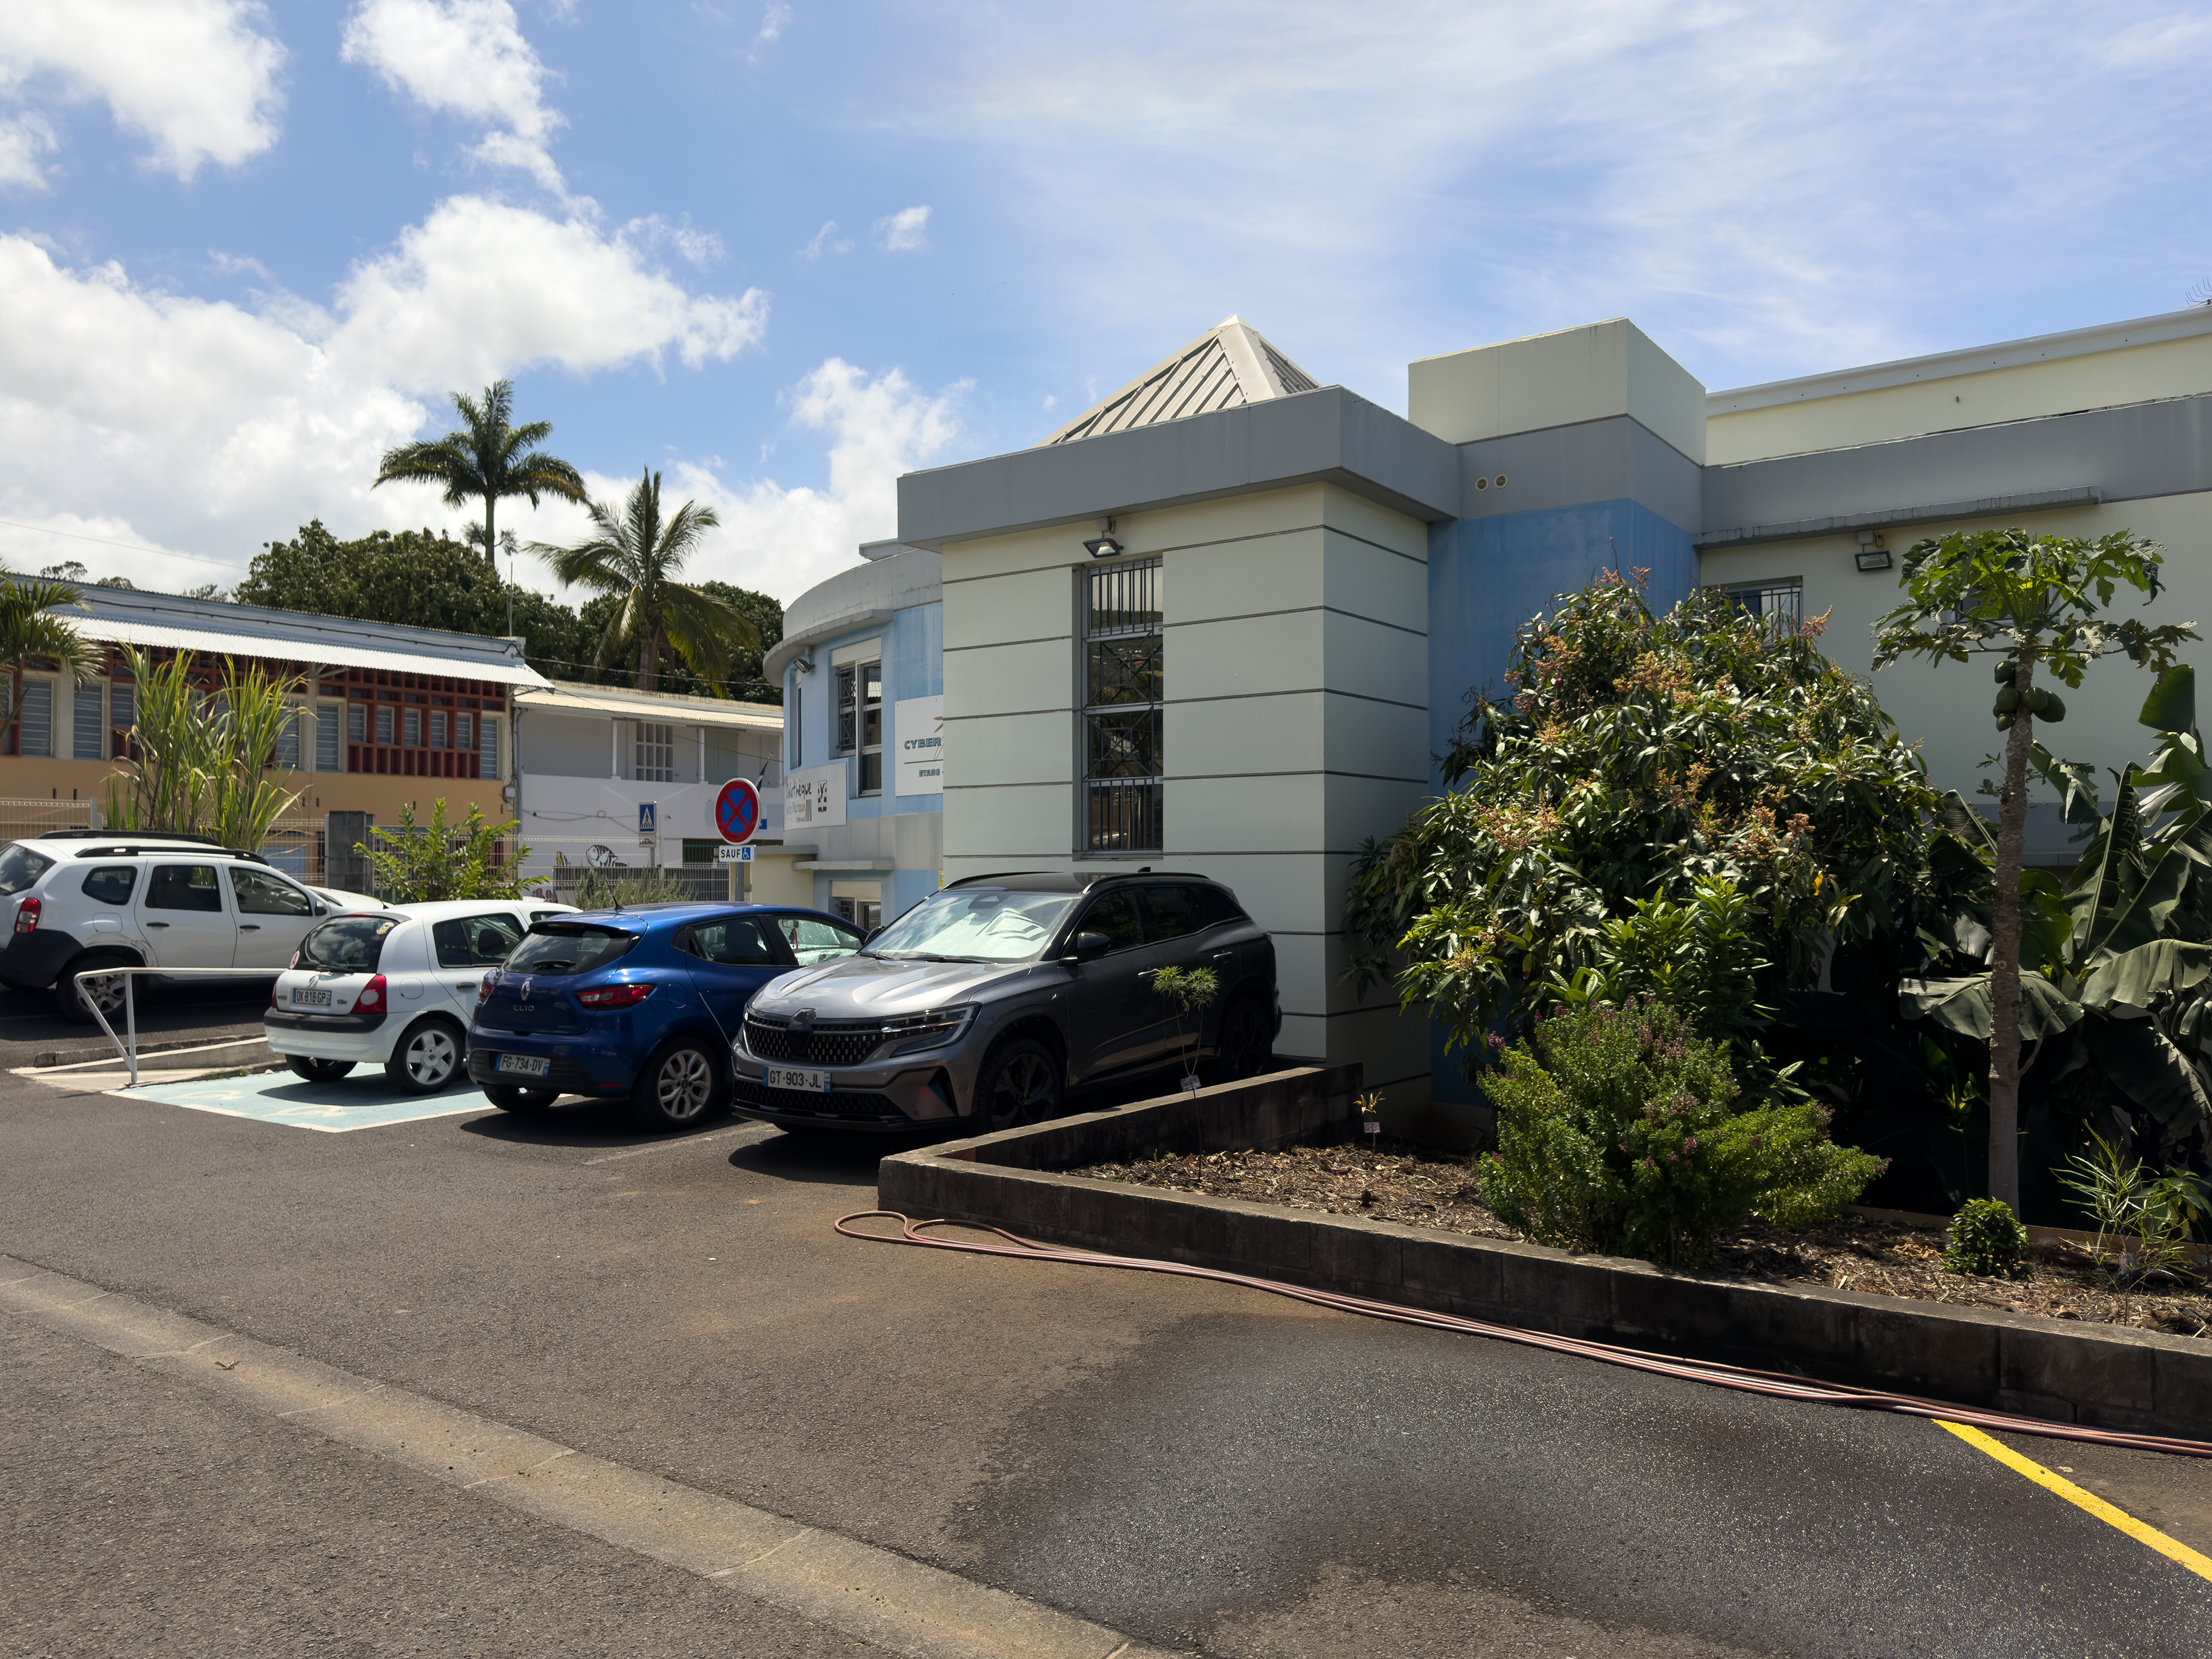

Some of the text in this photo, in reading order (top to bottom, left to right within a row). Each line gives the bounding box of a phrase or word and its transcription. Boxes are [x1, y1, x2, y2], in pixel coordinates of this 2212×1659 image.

[904, 737, 941, 749] CYBER
[919, 768, 940, 777] ETANG
[721, 849, 741, 858] SAUF
[297, 991, 326, 1003] DK-818-GP
[501, 1056, 543, 1071] FG-734-DV
[770, 1070, 821, 1088] GT-903-JL
